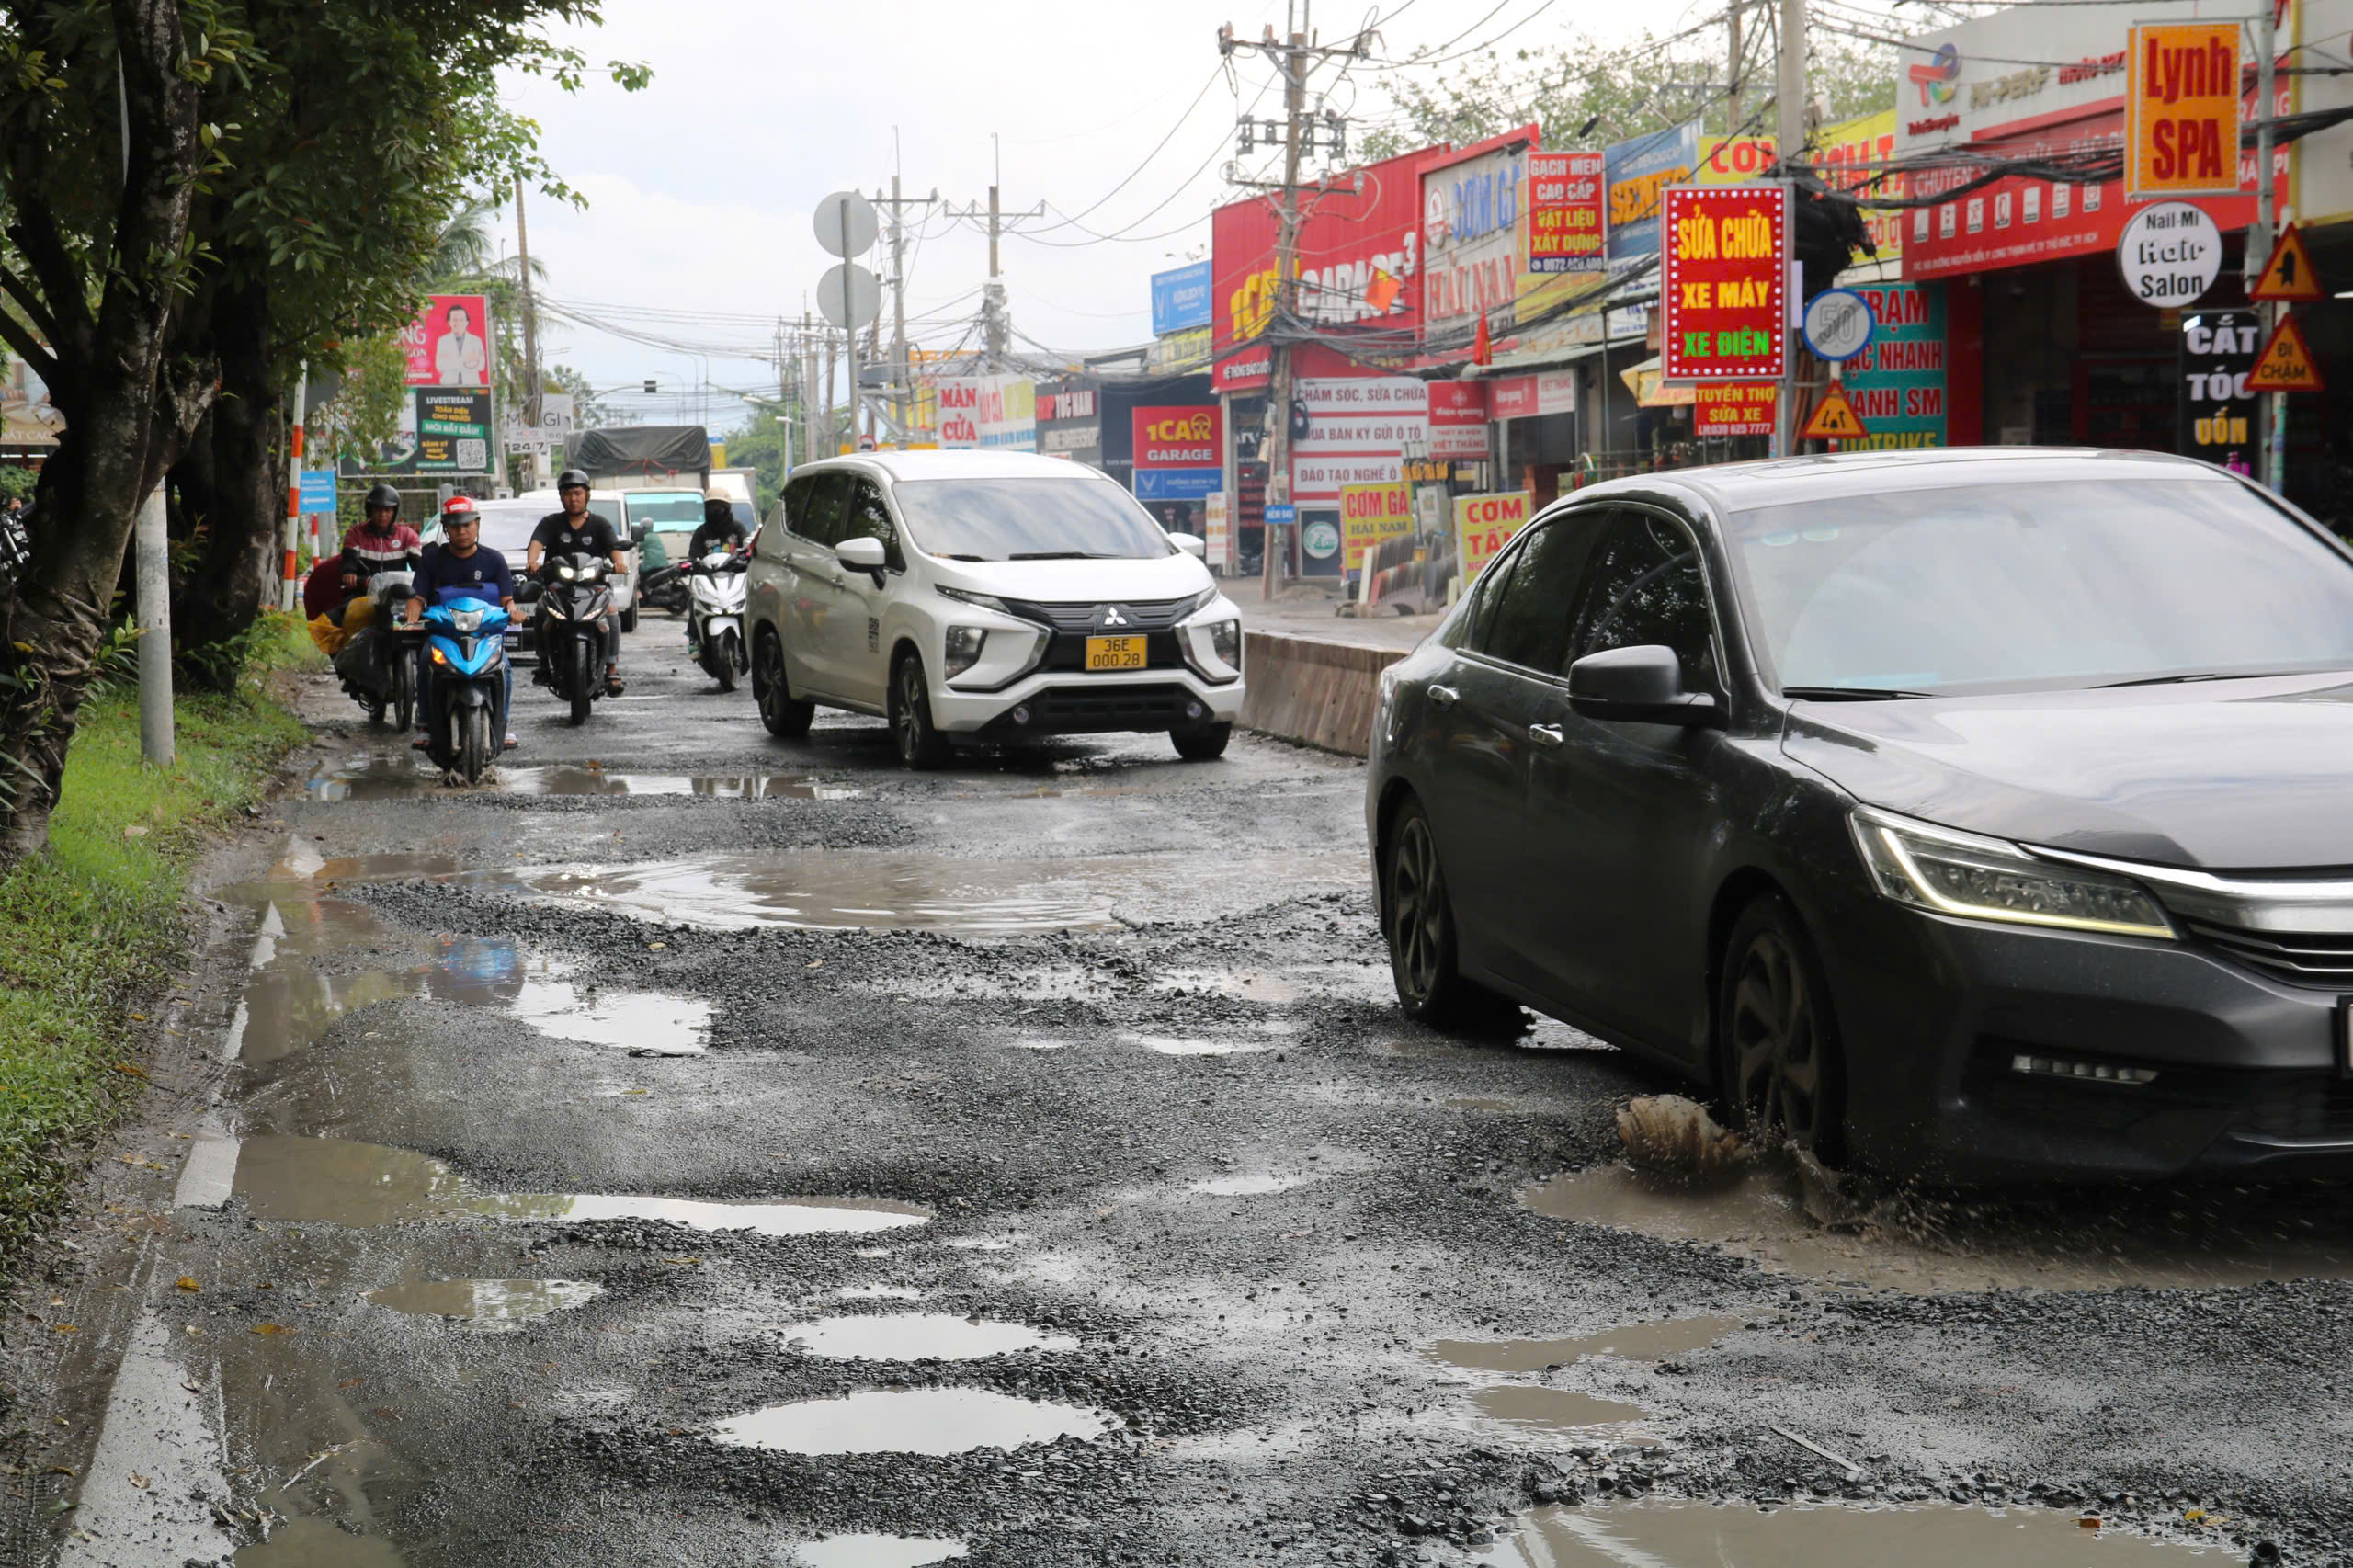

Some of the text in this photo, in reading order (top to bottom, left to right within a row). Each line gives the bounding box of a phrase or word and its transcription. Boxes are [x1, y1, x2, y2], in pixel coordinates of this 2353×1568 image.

[2147, 36, 2232, 105] Lynh
[2152, 119, 2223, 180] SPA
[1529, 159, 1567, 180] GẠCH
[1569, 158, 1602, 176] MEN
[1536, 177, 1596, 200] CAO CẤP
[1538, 208, 1596, 232] VẬT LIỆU
[1678, 204, 1772, 259] SỬA CHỮA
[1533, 232, 1601, 255] XÂY DỰNG
[1681, 276, 1769, 309] XE MÁY
[2141, 273, 2203, 299] Salon
[1820, 304, 1856, 345] 50
[2186, 313, 2258, 355] CẮT
[1683, 324, 1769, 361] XE ĐIỆN
[1880, 341, 1942, 371] NHANH
[1368, 385, 1391, 402] SỬA
[1394, 384, 1427, 402] CHỮA
[2186, 365, 2256, 402] TÓC
[426, 396, 473, 405] LIVESTREAM
[1709, 404, 1762, 423] SỬA XE
[1906, 388, 1942, 416] SM
[943, 413, 977, 441] CỬA
[1146, 413, 1211, 442] 1CAR
[1408, 425, 1421, 439] TÔ
[2194, 405, 2248, 446] UỐN
[1147, 449, 1212, 461] GARAGE
[1301, 468, 1324, 483] ĐÀO
[1354, 465, 1385, 482] NGHỀ
[1347, 484, 1409, 518] CƠM GÀ
[1467, 498, 1523, 523] CƠM
[1378, 521, 1408, 533] NAM
[1104, 639, 1131, 652] 36E
[1093, 653, 1141, 667] 000.28
